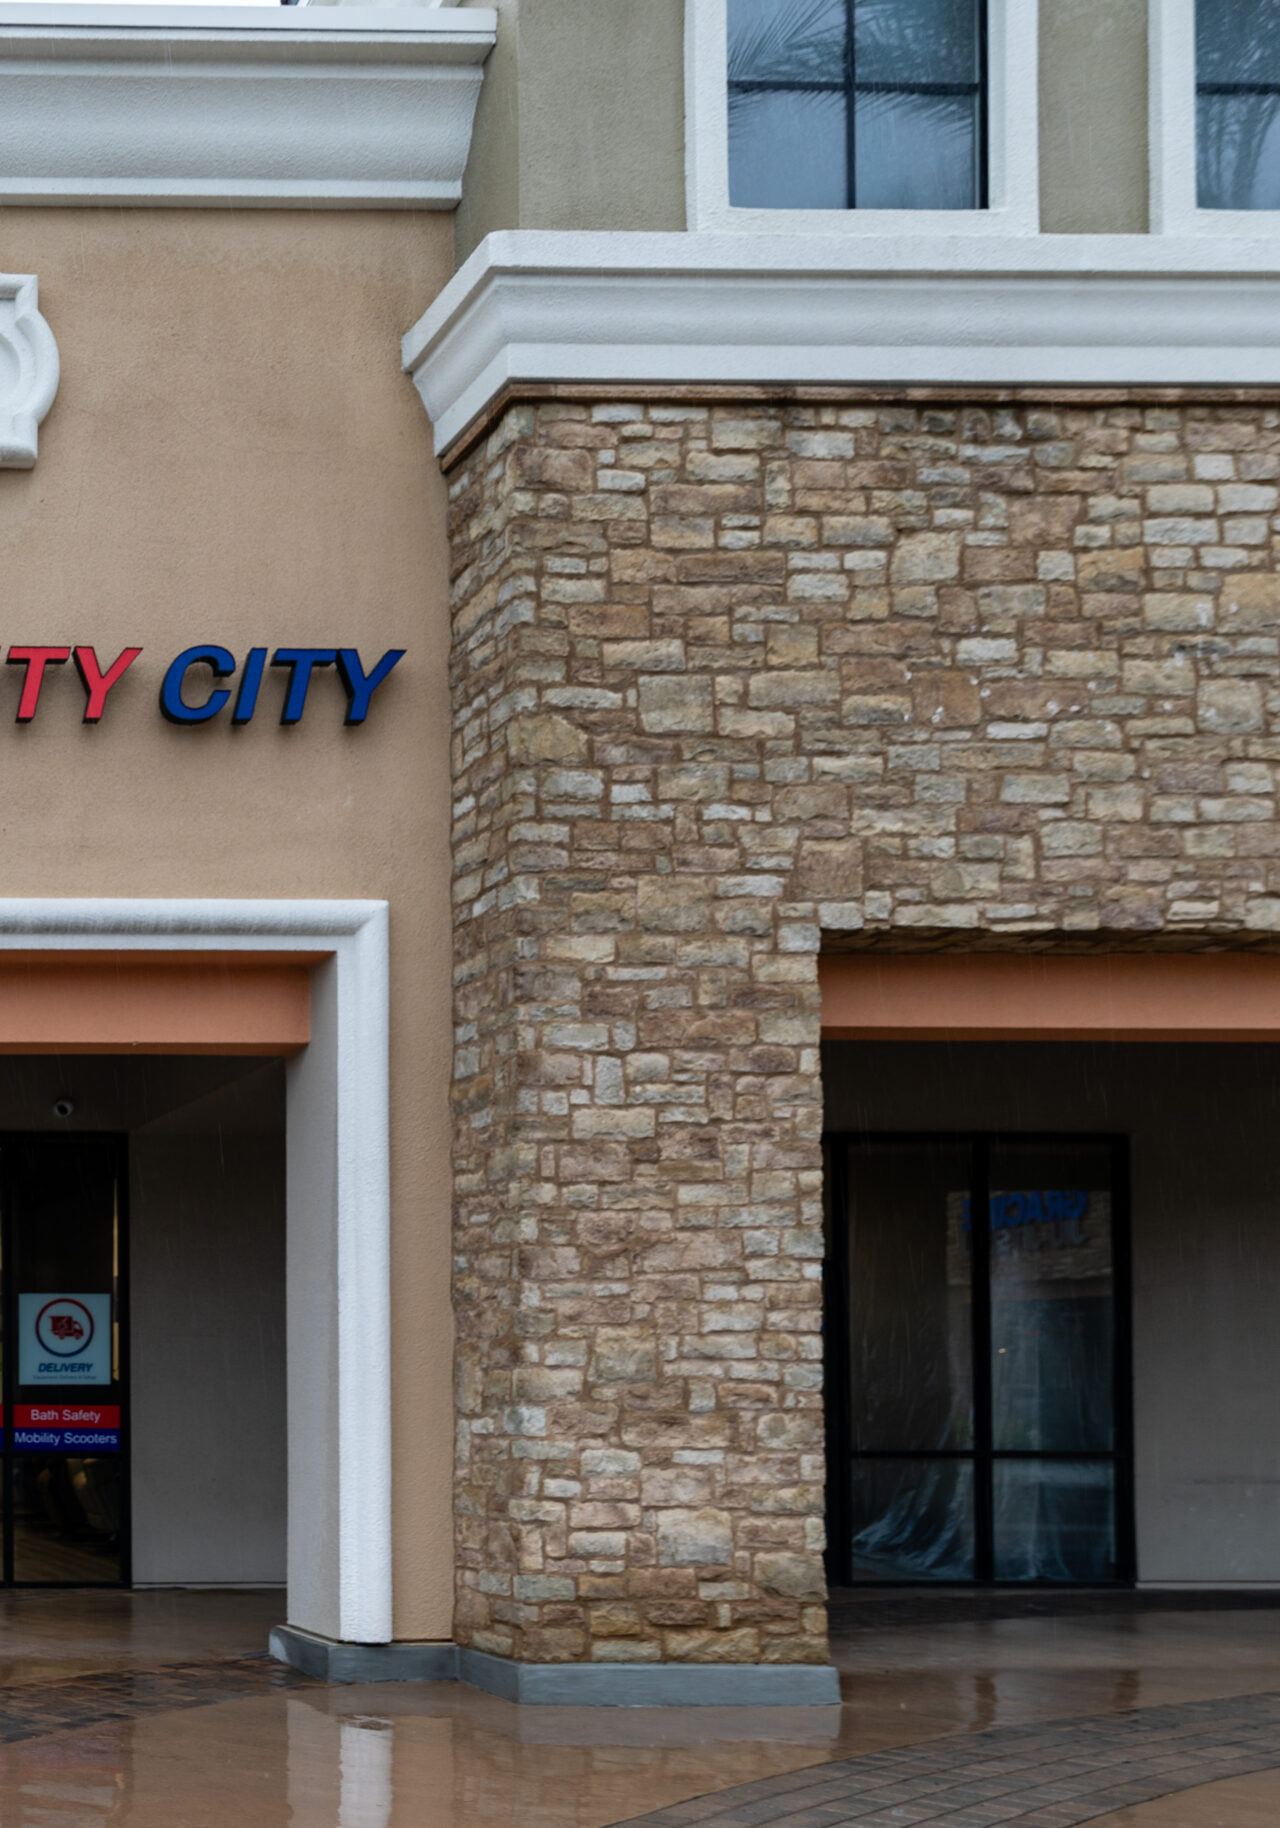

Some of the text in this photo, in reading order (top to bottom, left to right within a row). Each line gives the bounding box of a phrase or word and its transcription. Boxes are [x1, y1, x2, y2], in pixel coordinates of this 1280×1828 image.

[159, 645, 408, 726] CITY
[38, 1363, 93, 1372] DELIVERY
[30, 1409, 101, 1424] Bath Safety
[14, 1431, 118, 1446] Mobility Scooters
